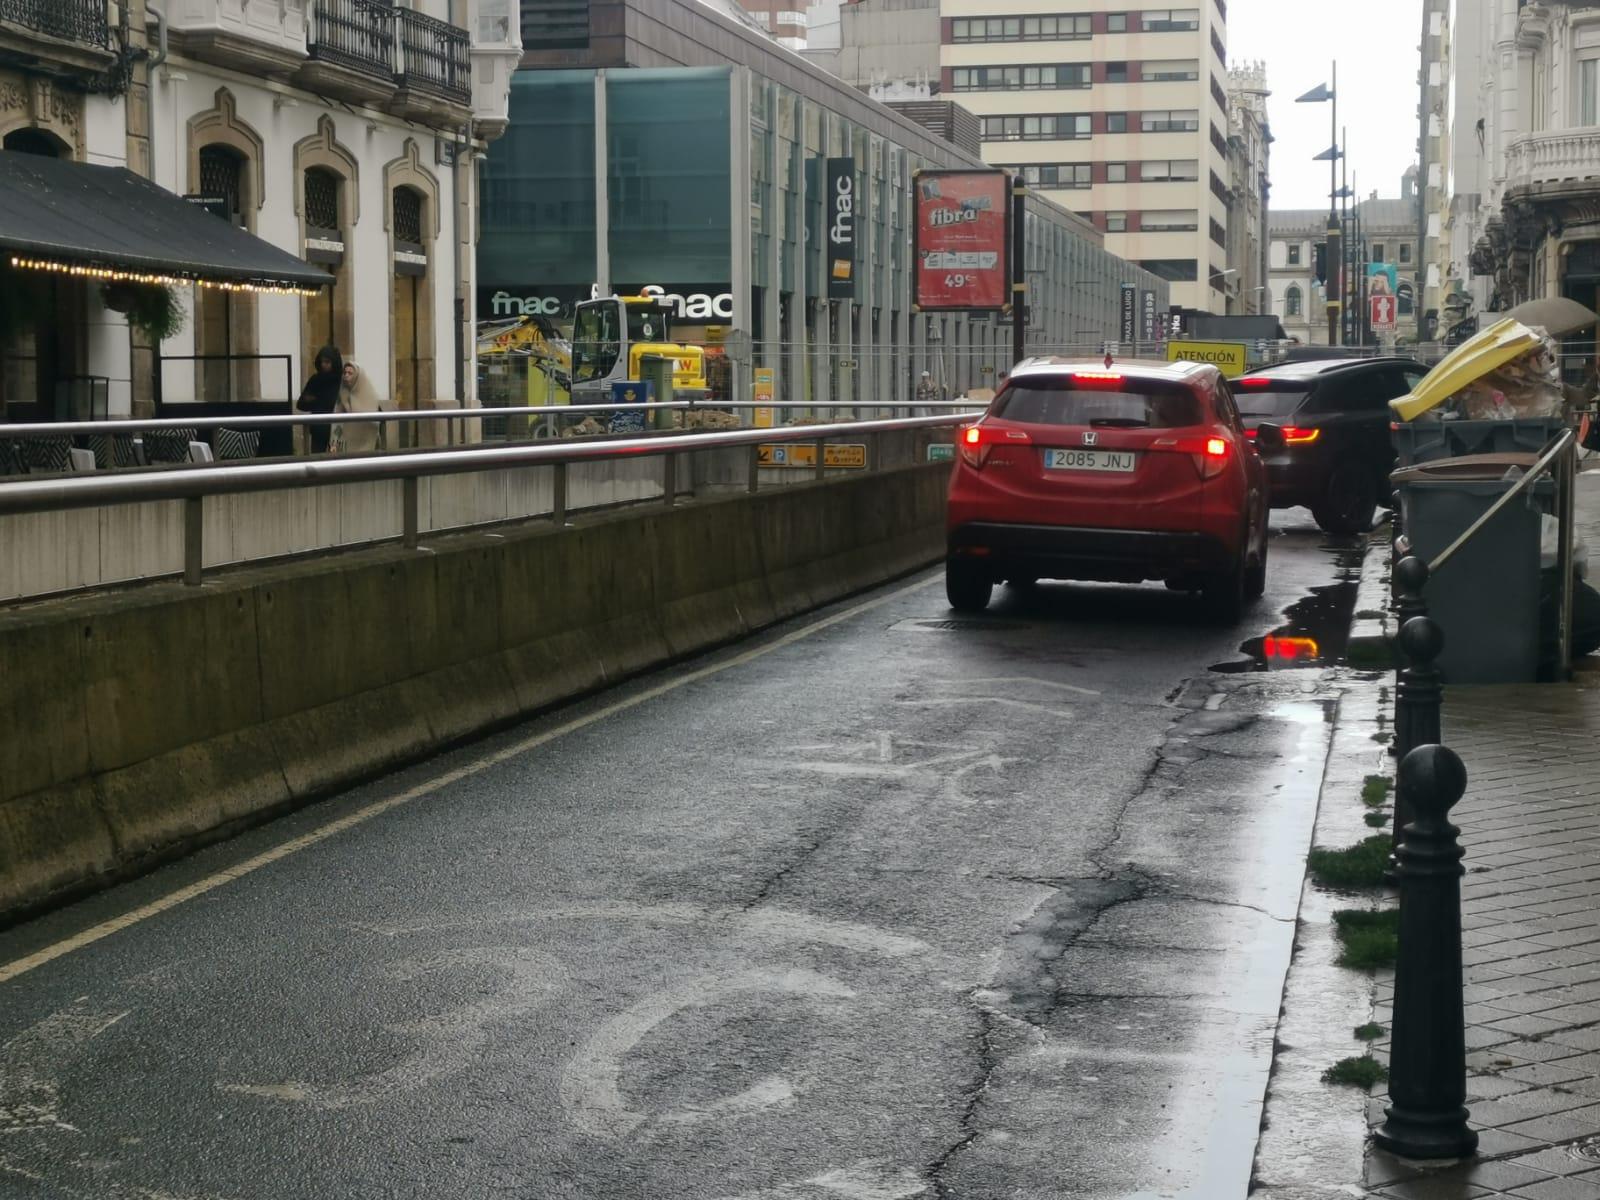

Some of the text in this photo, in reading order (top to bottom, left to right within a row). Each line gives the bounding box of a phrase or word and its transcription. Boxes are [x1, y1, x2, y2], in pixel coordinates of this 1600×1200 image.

[830, 175, 852, 244] fnac
[930, 208, 977, 226] fibra
[491, 291, 561, 315] fnac
[1175, 350, 1236, 363] ATENCIÓN
[1056, 452, 1132, 469] 2085 JNJ
